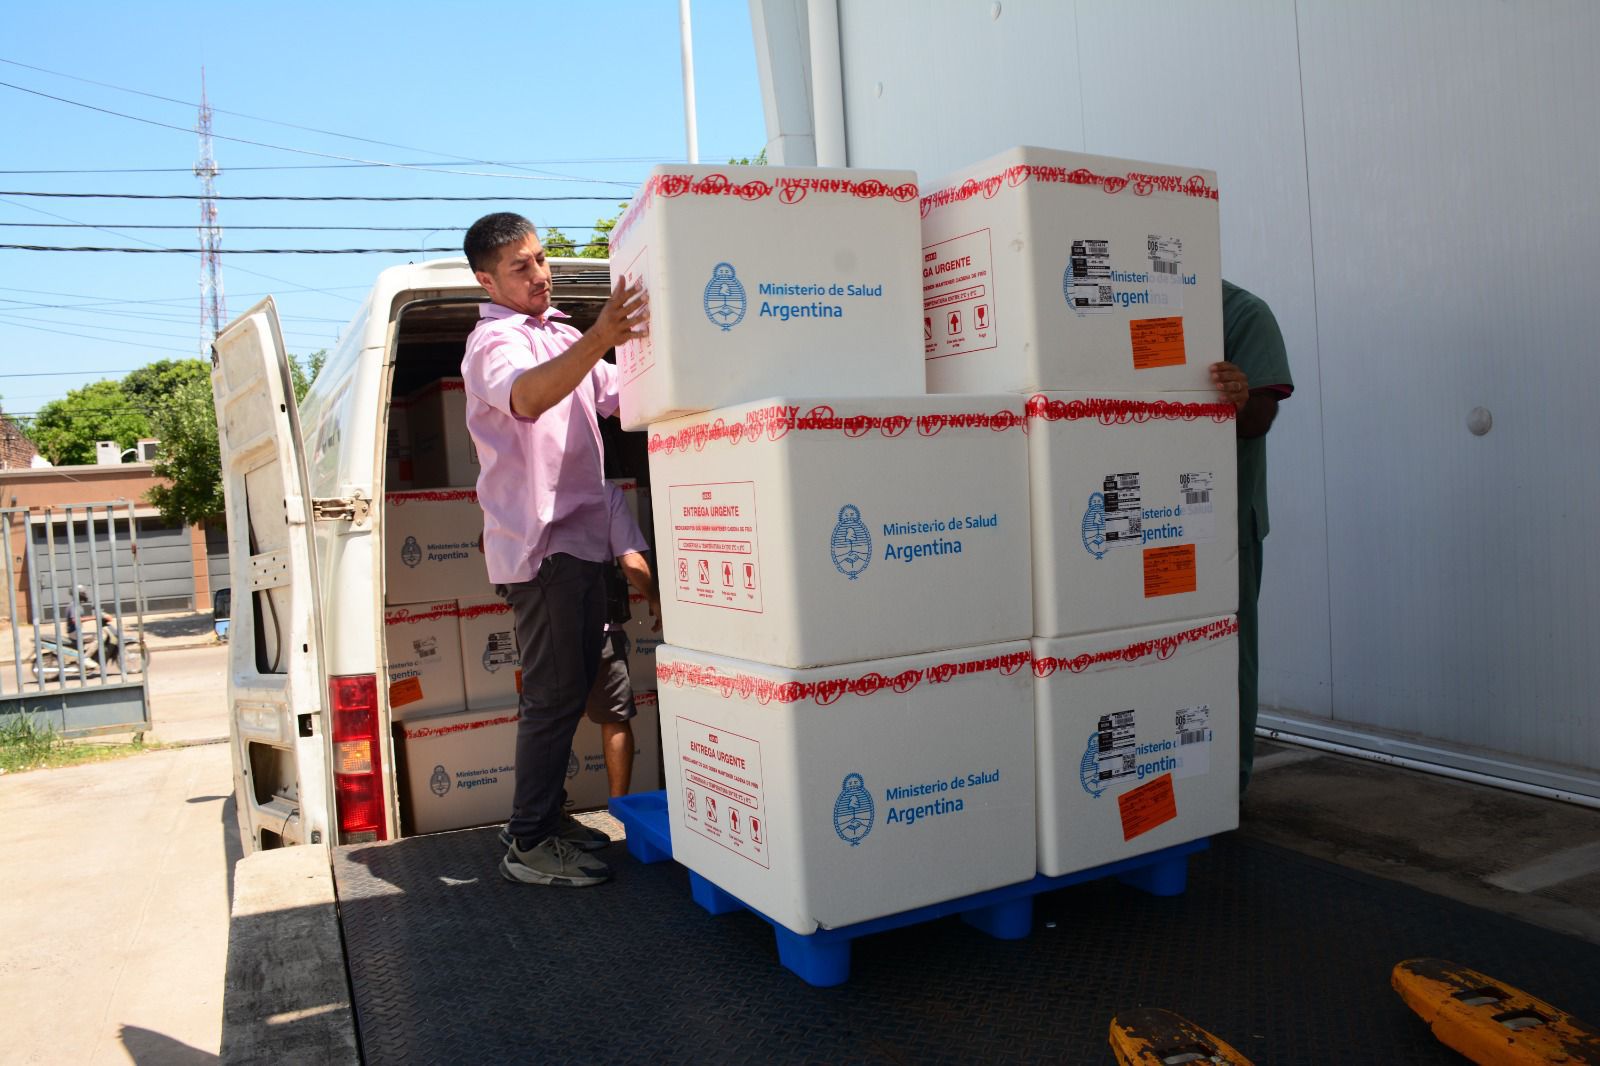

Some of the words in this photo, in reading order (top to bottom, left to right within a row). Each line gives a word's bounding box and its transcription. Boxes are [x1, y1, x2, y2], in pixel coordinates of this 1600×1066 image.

[935, 256, 971, 275] URGENTE
[760, 284, 825, 296] Ministerio
[829, 284, 844, 296] de
[847, 285, 882, 297] Salud
[760, 302, 843, 321] Argentina
[746, 405, 800, 423] ANDREANI
[683, 506, 709, 517] ENTREGA
[711, 506, 739, 517] URGENTE
[884, 520, 945, 536] Ministerio
[949, 517, 962, 530] de
[966, 513, 997, 528] Salud
[428, 551, 469, 562] Argentina
[885, 538, 962, 562] Argentina
[690, 741, 716, 760] ENTREGA
[716, 749, 746, 770] URGENTE
[456, 769, 488, 778] Ministerio
[490, 767, 497, 775] de
[457, 777, 498, 789] Argentina
[886, 779, 948, 801] Ministerio
[951, 776, 965, 790] de
[968, 769, 999, 787] Salud
[886, 797, 963, 825] Argentina
